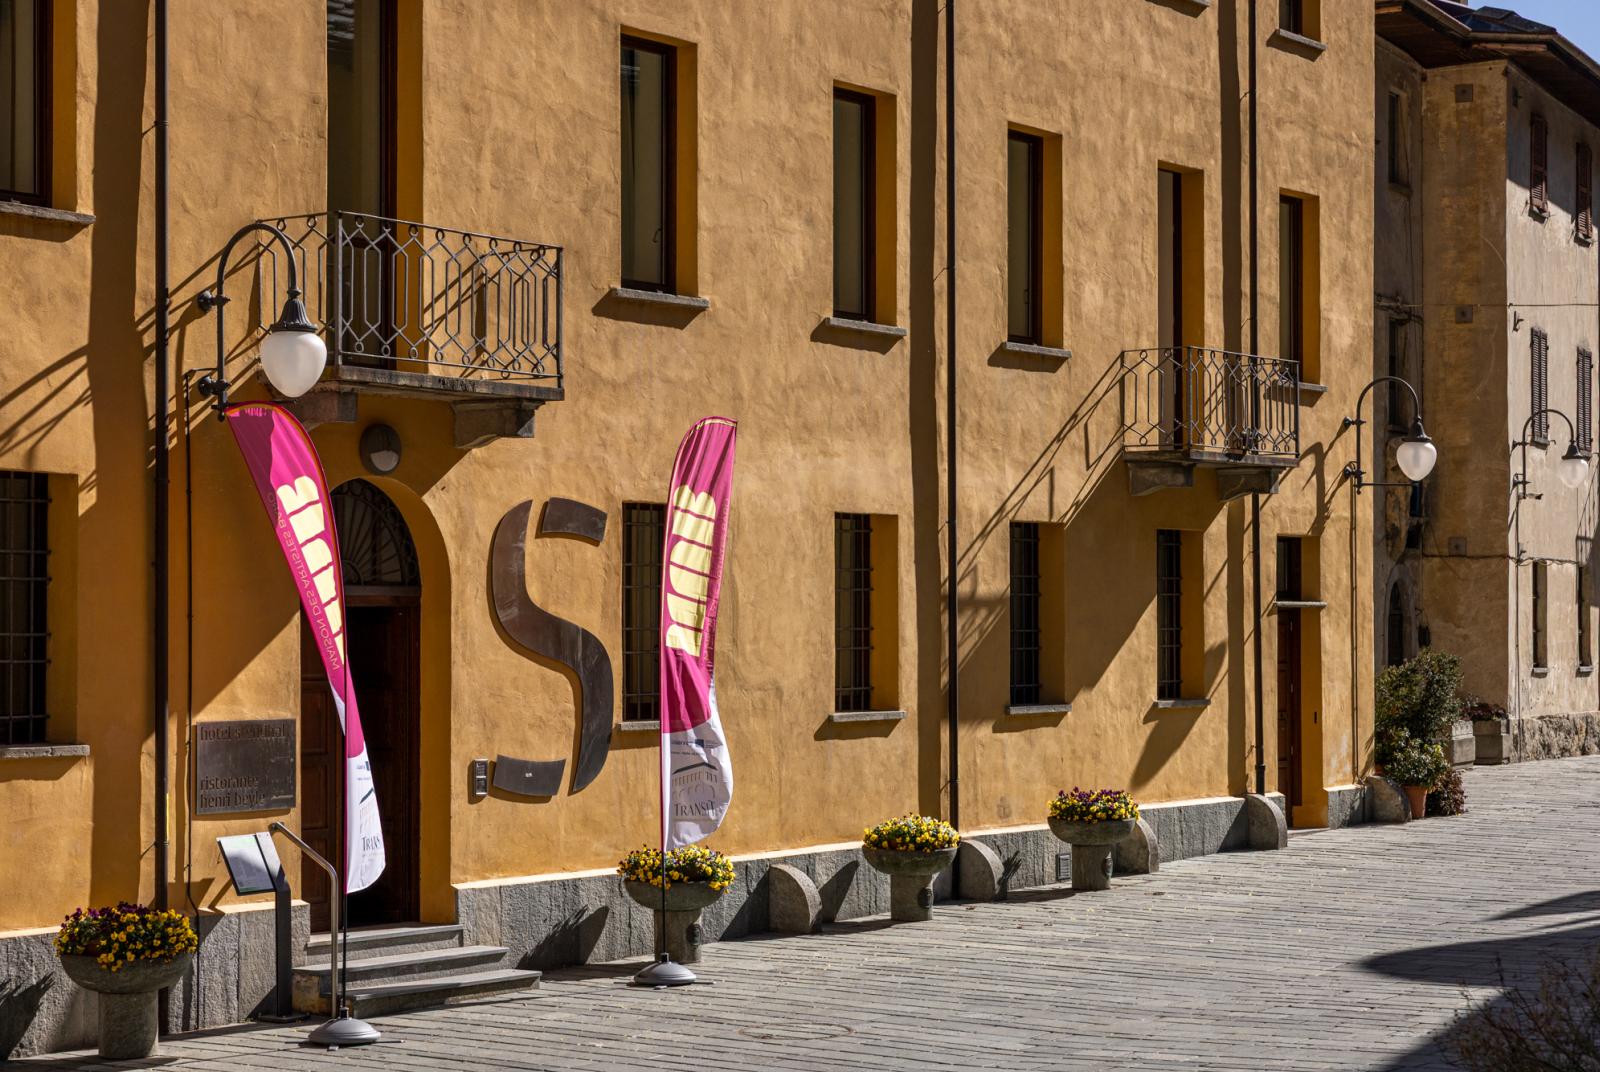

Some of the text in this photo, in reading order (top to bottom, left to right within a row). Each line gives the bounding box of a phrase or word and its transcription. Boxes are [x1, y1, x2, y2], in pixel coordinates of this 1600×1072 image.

[200, 725, 232, 741] hotel
[200, 775, 259, 791] ristorante
[200, 792, 231, 809] henri
[233, 790, 265, 808] beyle
